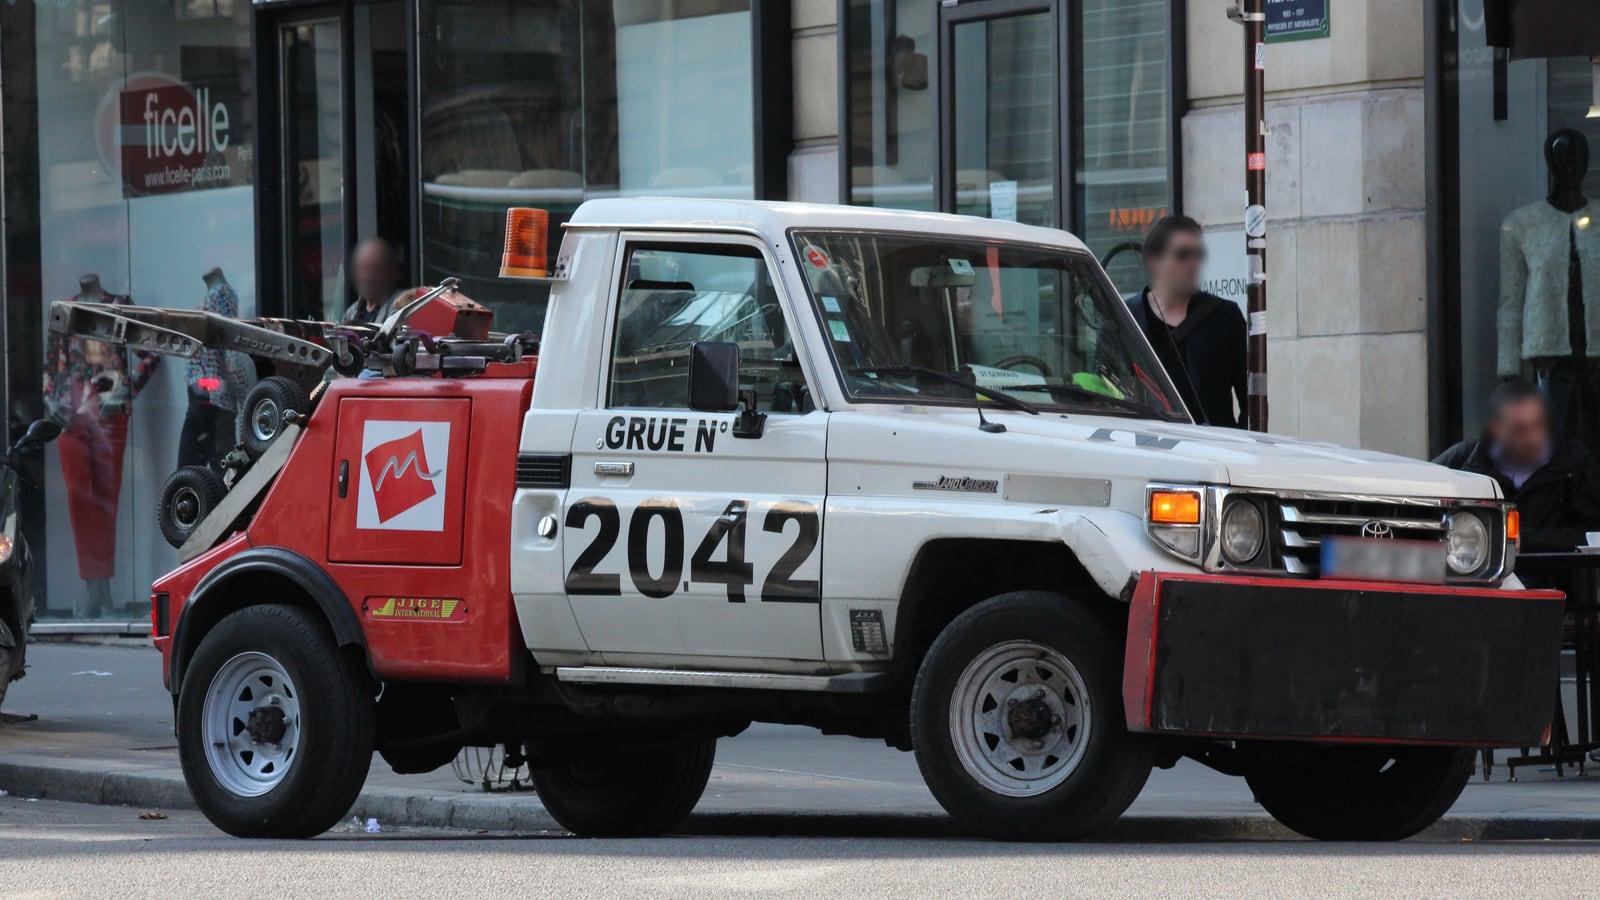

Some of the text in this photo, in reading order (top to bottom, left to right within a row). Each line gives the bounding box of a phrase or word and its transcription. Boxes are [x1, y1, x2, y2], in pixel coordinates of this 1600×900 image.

[1287, 21, 1293, 29] ET
[144, 87, 229, 159] ficelle
[144, 162, 231, 187] www.ficelle-paris.com
[605, 416, 728, 453] GRUE N°
[398, 598, 441, 609] JIGE
[394, 609, 441, 618] INTERNATIONAL
